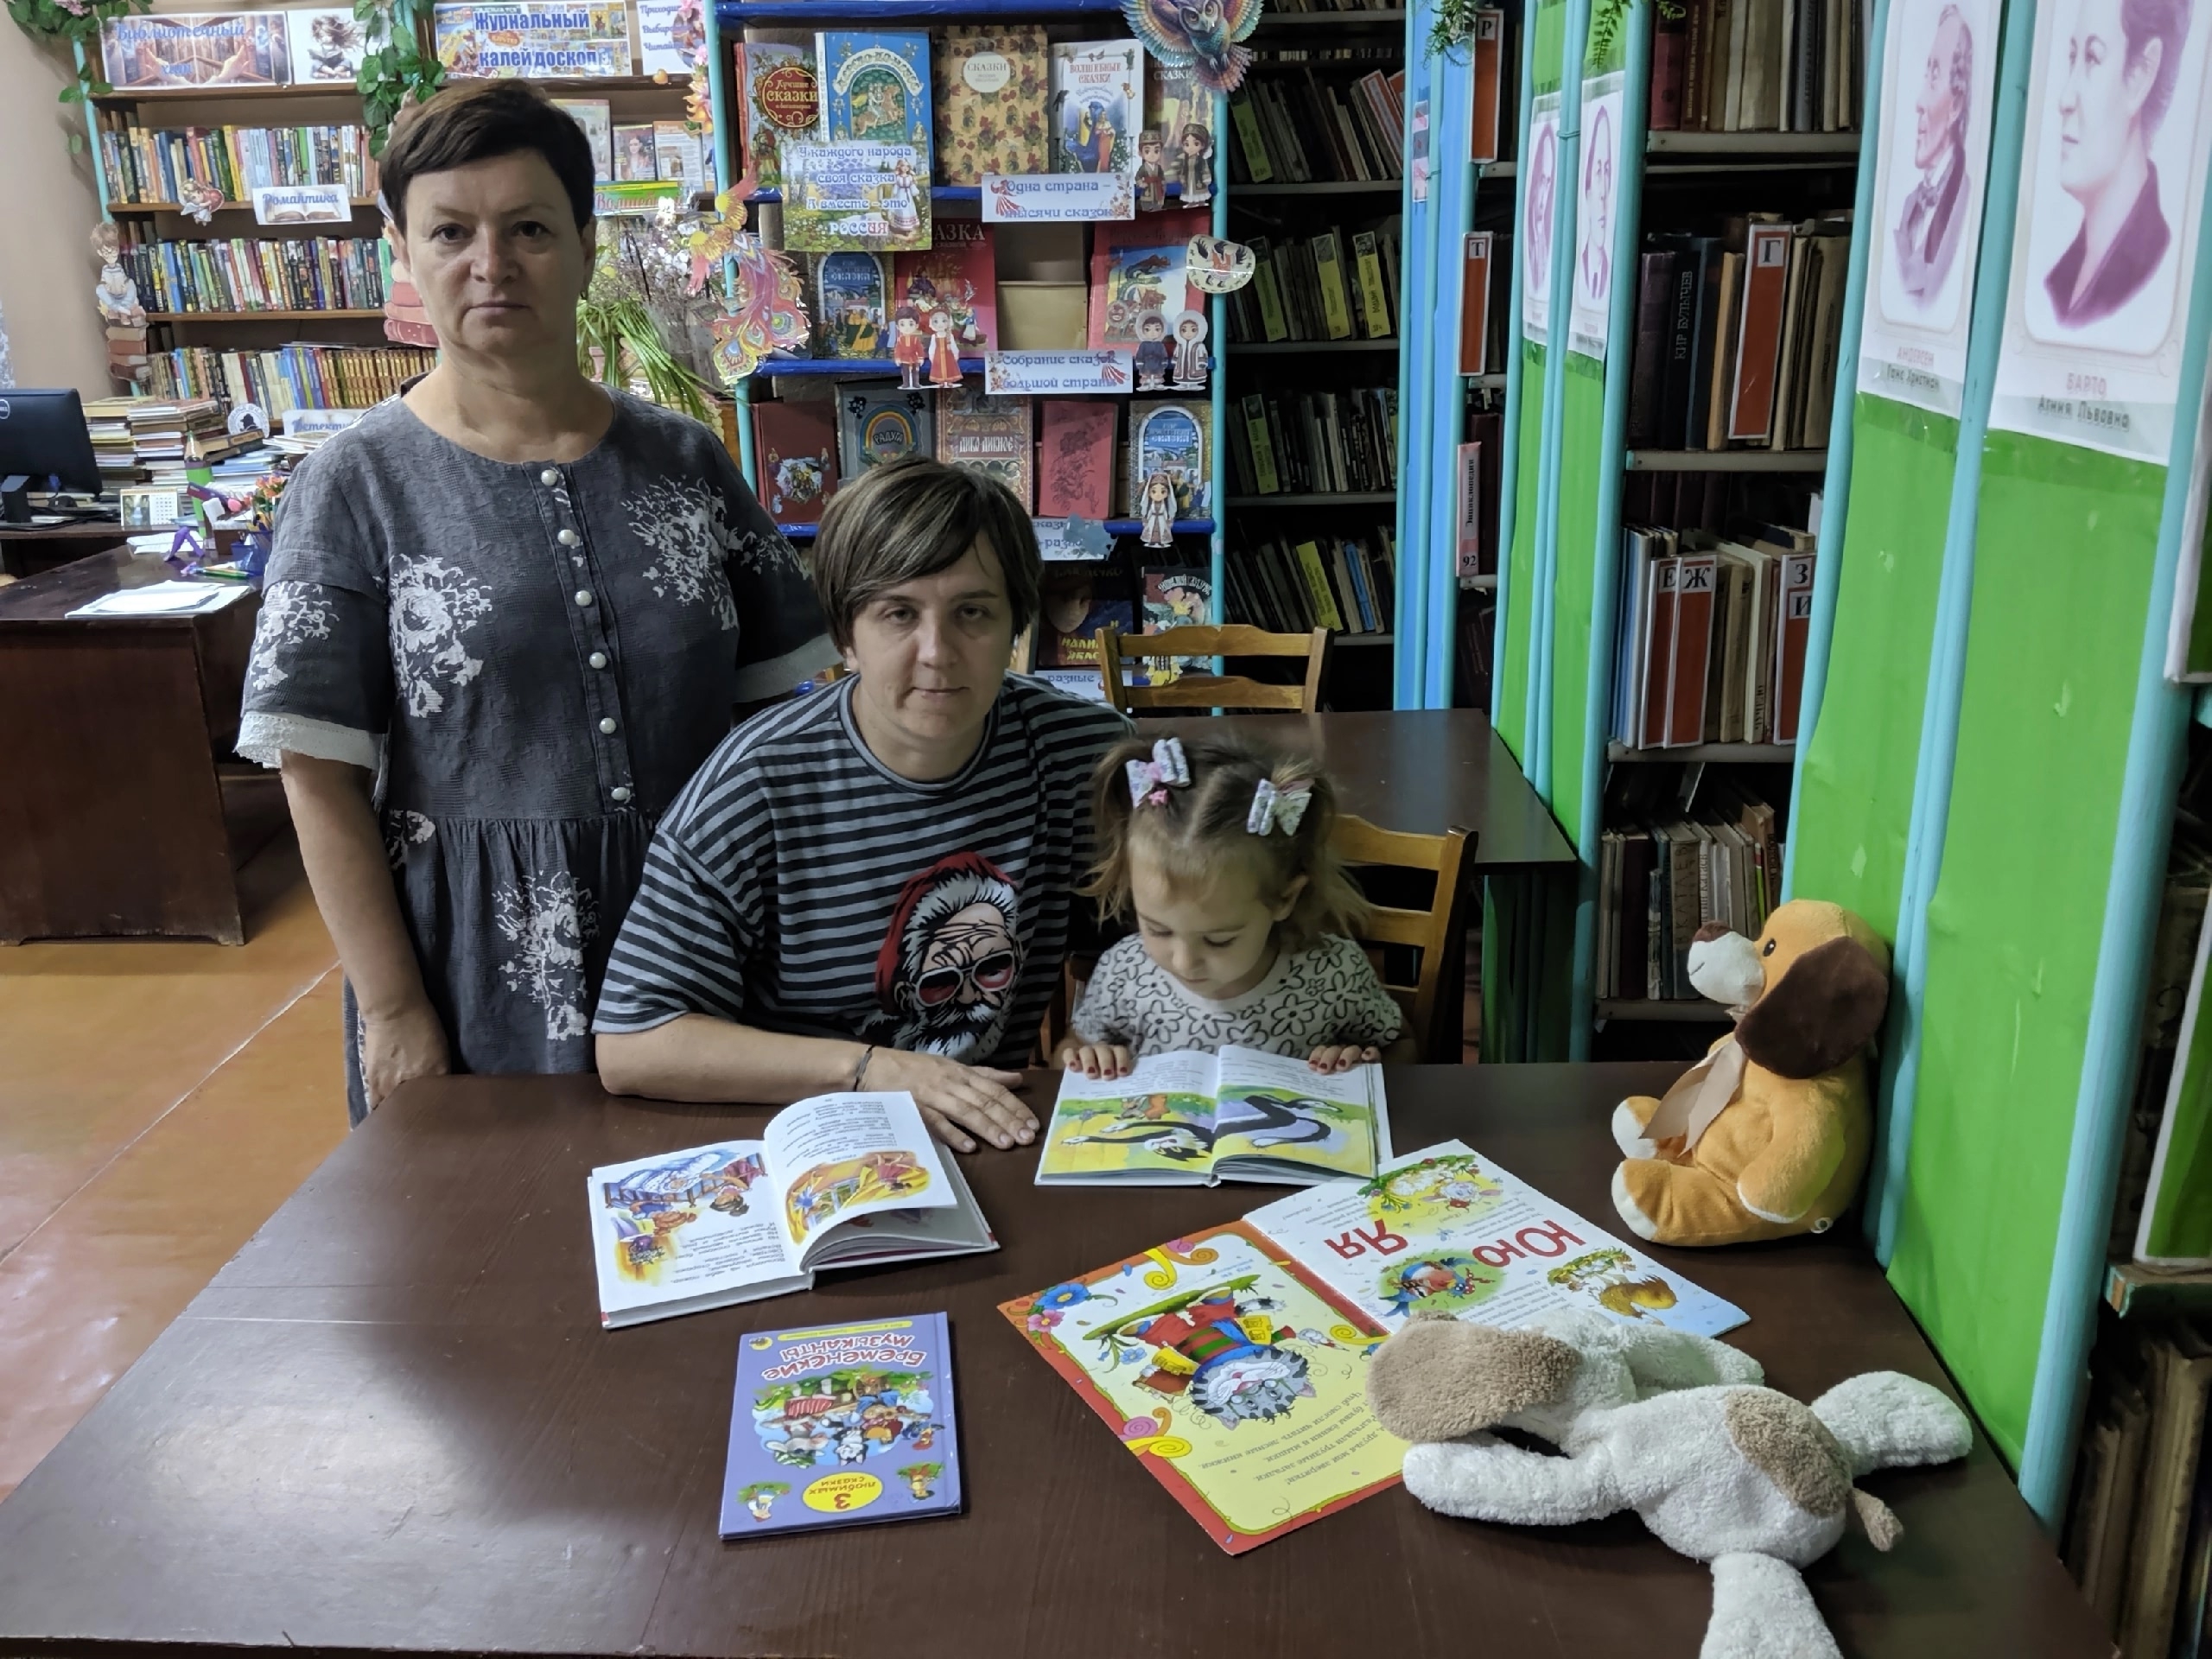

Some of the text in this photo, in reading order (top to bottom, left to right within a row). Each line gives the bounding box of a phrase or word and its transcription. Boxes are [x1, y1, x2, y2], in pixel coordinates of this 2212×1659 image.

[474, 10, 589, 31] Журнальный
[118, 22, 244, 41] Библиотечный
[1481, 21, 1492, 36] Р
[480, 48, 596, 68] калейдоскоп
[1070, 62, 1121, 73] ВОЛШЕБНЫЕ
[1154, 70, 1193, 80] СКАЗКИ
[1078, 73, 1111, 83] СКАЗКИ
[767, 90, 818, 102] сказки
[799, 146, 912, 158] У каждого народа
[817, 174, 895, 185] своя сказка
[1006, 181, 1040, 194] Одна
[1045, 181, 1099, 195] страна
[263, 193, 339, 205] Романтика
[807, 199, 817, 209] А
[820, 200, 869, 209] вместе
[883, 200, 908, 209] это
[1005, 207, 1113, 219] тысячи сказок
[829, 221, 889, 236] РОССИЯ
[934, 224, 986, 241] АЗКА
[1471, 242, 1484, 257] Т
[1763, 239, 1781, 263] Г
[1675, 270, 1693, 359] КИР БУЛЫЧЕВ
[1002, 354, 1116, 366] Собрание сказок
[1003, 378, 1117, 390] большой страны
[2066, 372, 2107, 398] БАРТО
[291, 416, 348, 432] Детекти
[874, 430, 904, 445] РАДУГА
[1463, 556, 1477, 567] 92
[1663, 567, 1676, 588] Е
[1685, 567, 1711, 588] Ж
[1047, 674, 1095, 683] разные
[834, 1493, 851, 1510] 3
